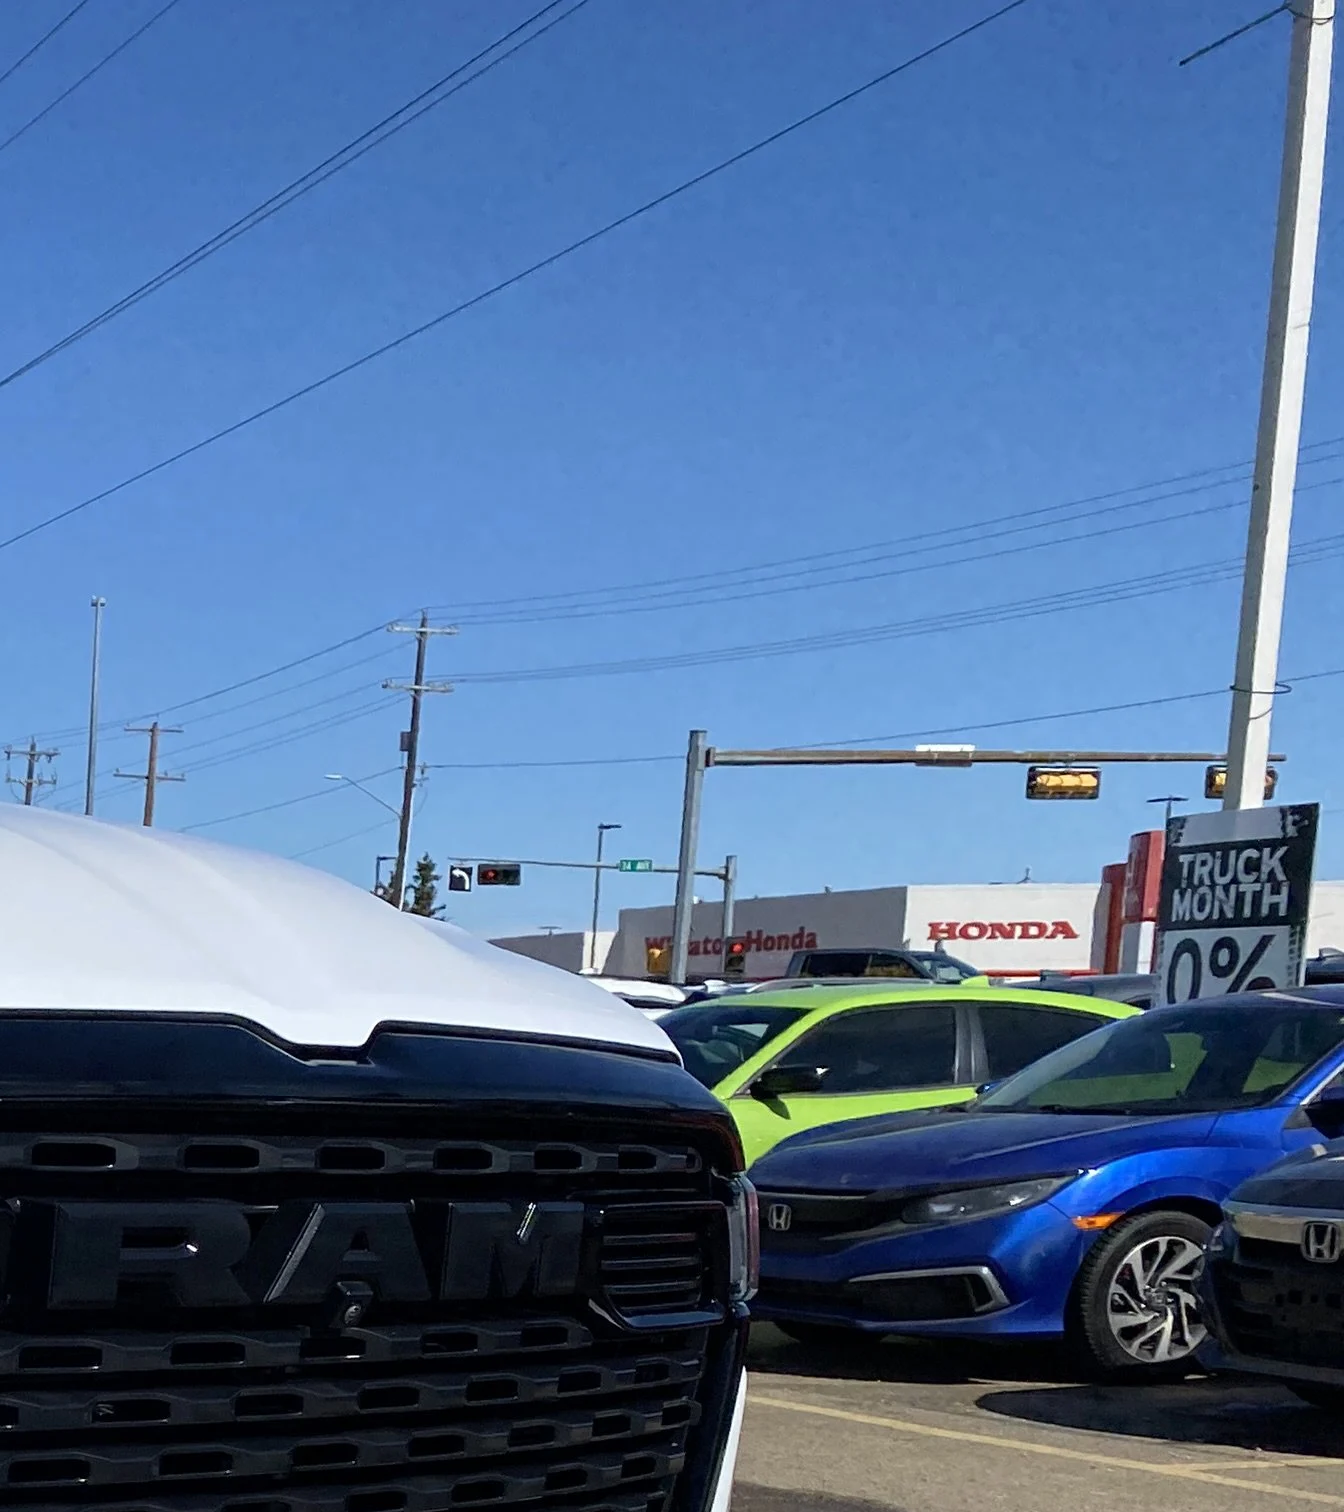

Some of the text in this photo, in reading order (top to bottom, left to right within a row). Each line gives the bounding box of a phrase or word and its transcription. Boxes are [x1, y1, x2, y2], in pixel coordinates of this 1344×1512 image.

[1178, 846, 1289, 888] TRUCK
[1171, 881, 1289, 922] MONTH
[745, 926, 818, 953] Honda
[927, 920, 1080, 942] HONDA
[46, 1198, 587, 1310] RAM
